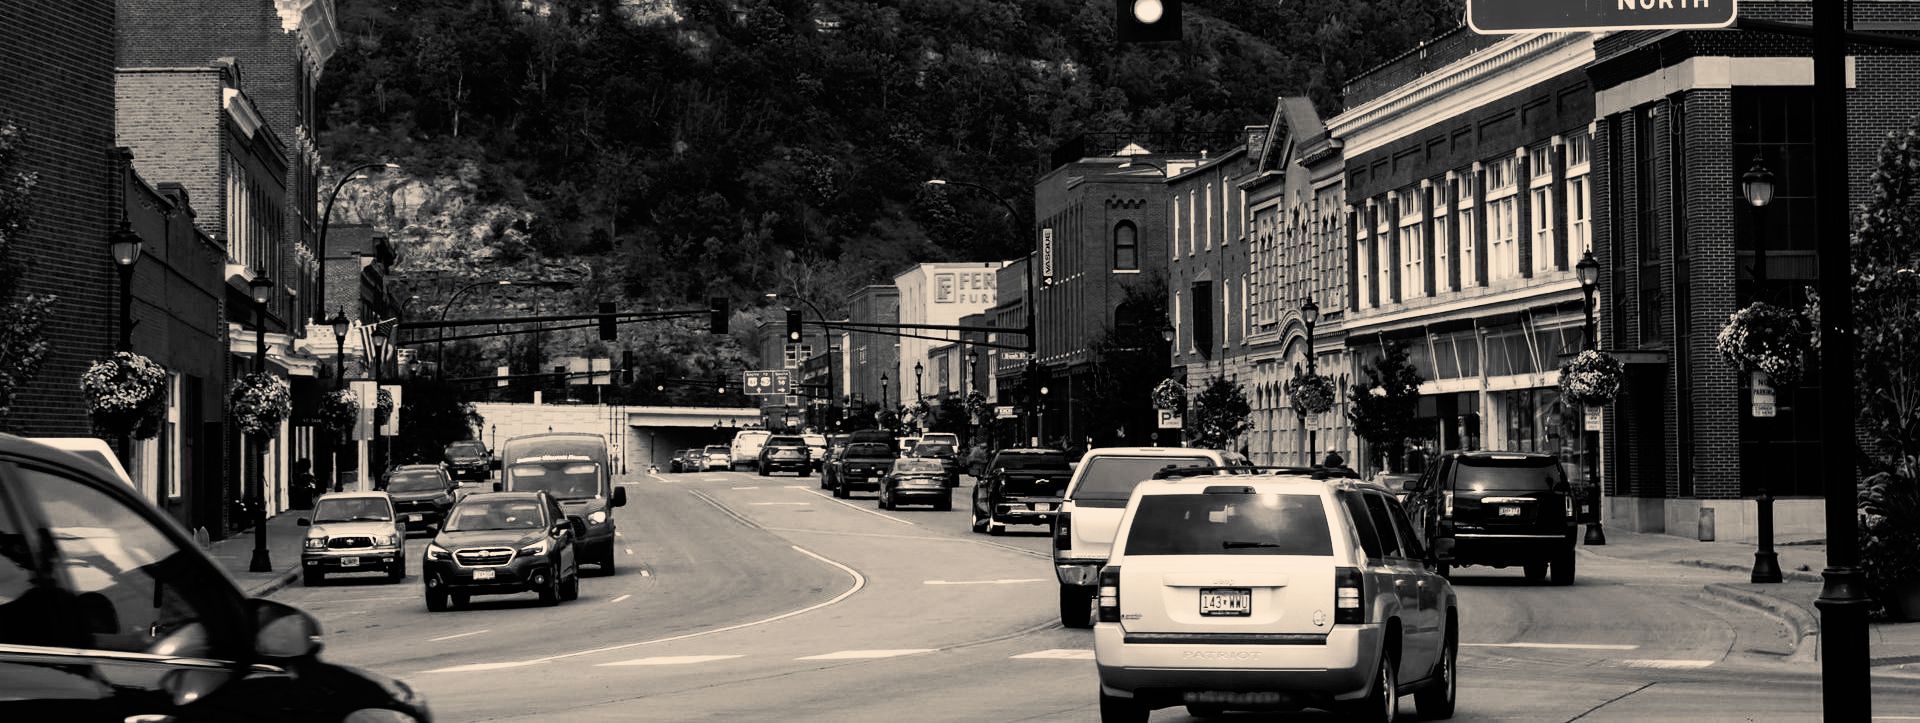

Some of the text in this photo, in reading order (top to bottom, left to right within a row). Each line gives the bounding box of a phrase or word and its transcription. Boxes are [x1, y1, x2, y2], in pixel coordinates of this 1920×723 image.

[1617, 0, 1709, 10] NORTH
[1161, 412, 1171, 425] P
[1183, 651, 1263, 661] PATRIOT
